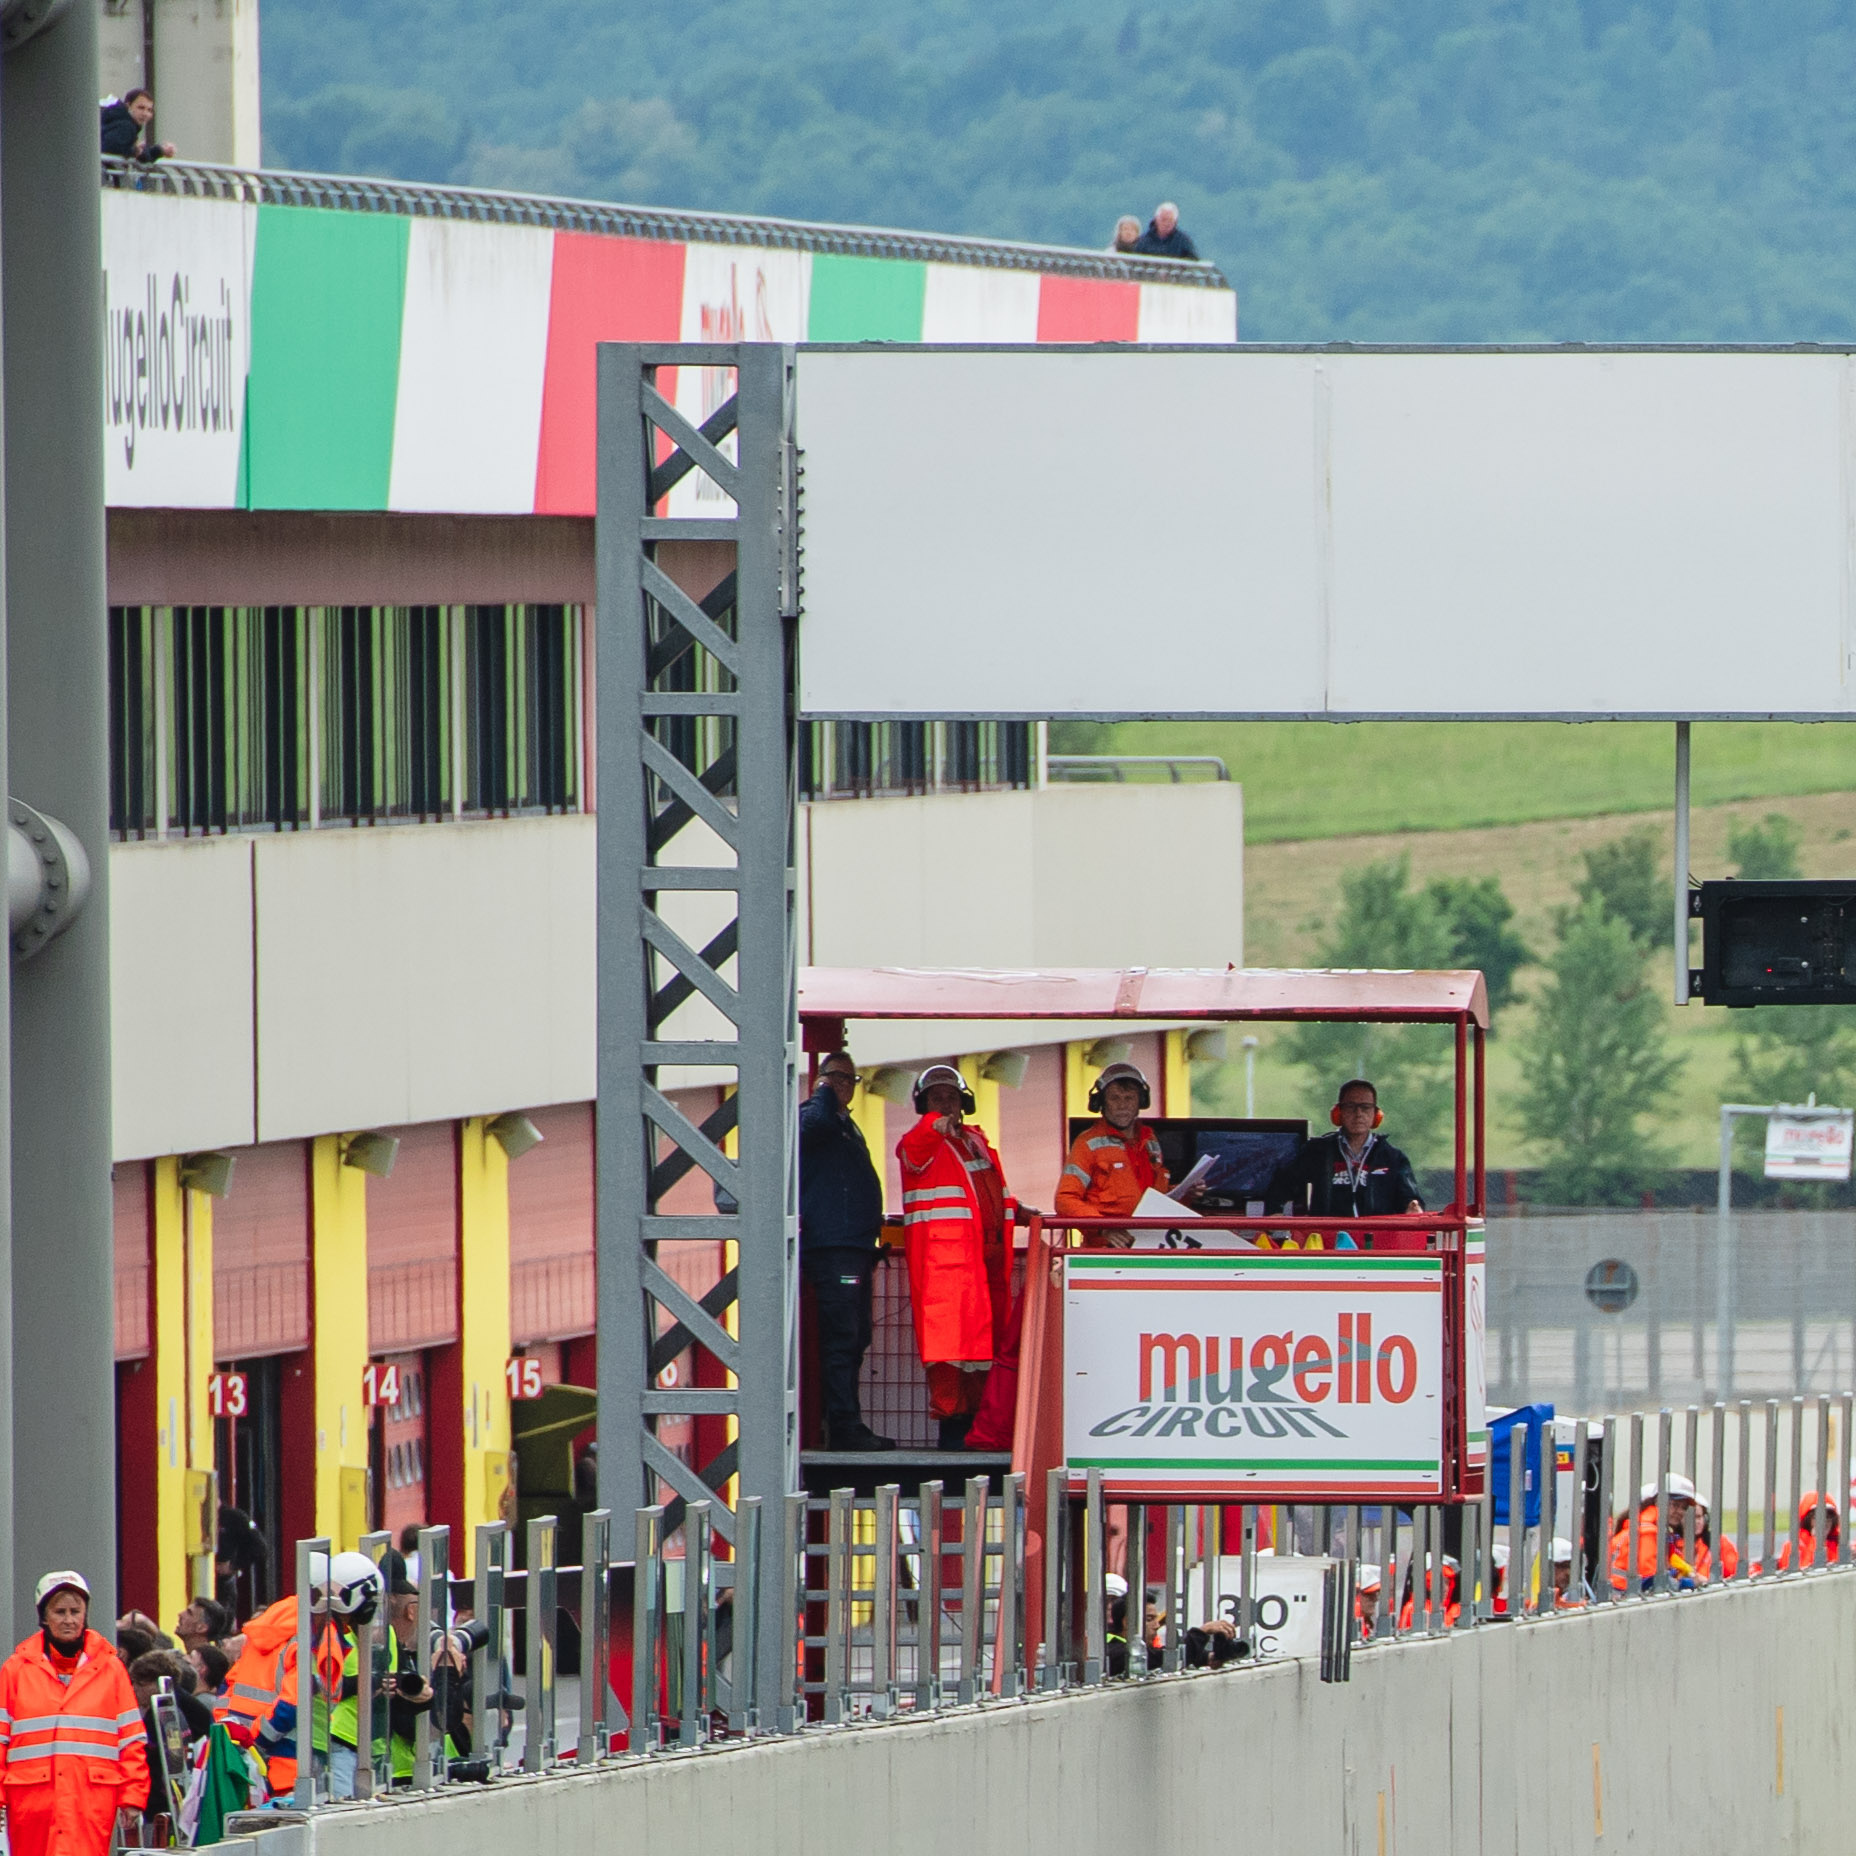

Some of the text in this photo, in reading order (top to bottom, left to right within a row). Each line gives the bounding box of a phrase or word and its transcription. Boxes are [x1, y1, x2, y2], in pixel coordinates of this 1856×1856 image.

[506, 1359, 542, 1398] 15
[1139, 1312, 1417, 1405] mugello
[208, 1374, 247, 1415] 13
[364, 1364, 400, 1405] 14
[1089, 1406, 1351, 1438] CIRCUIT
